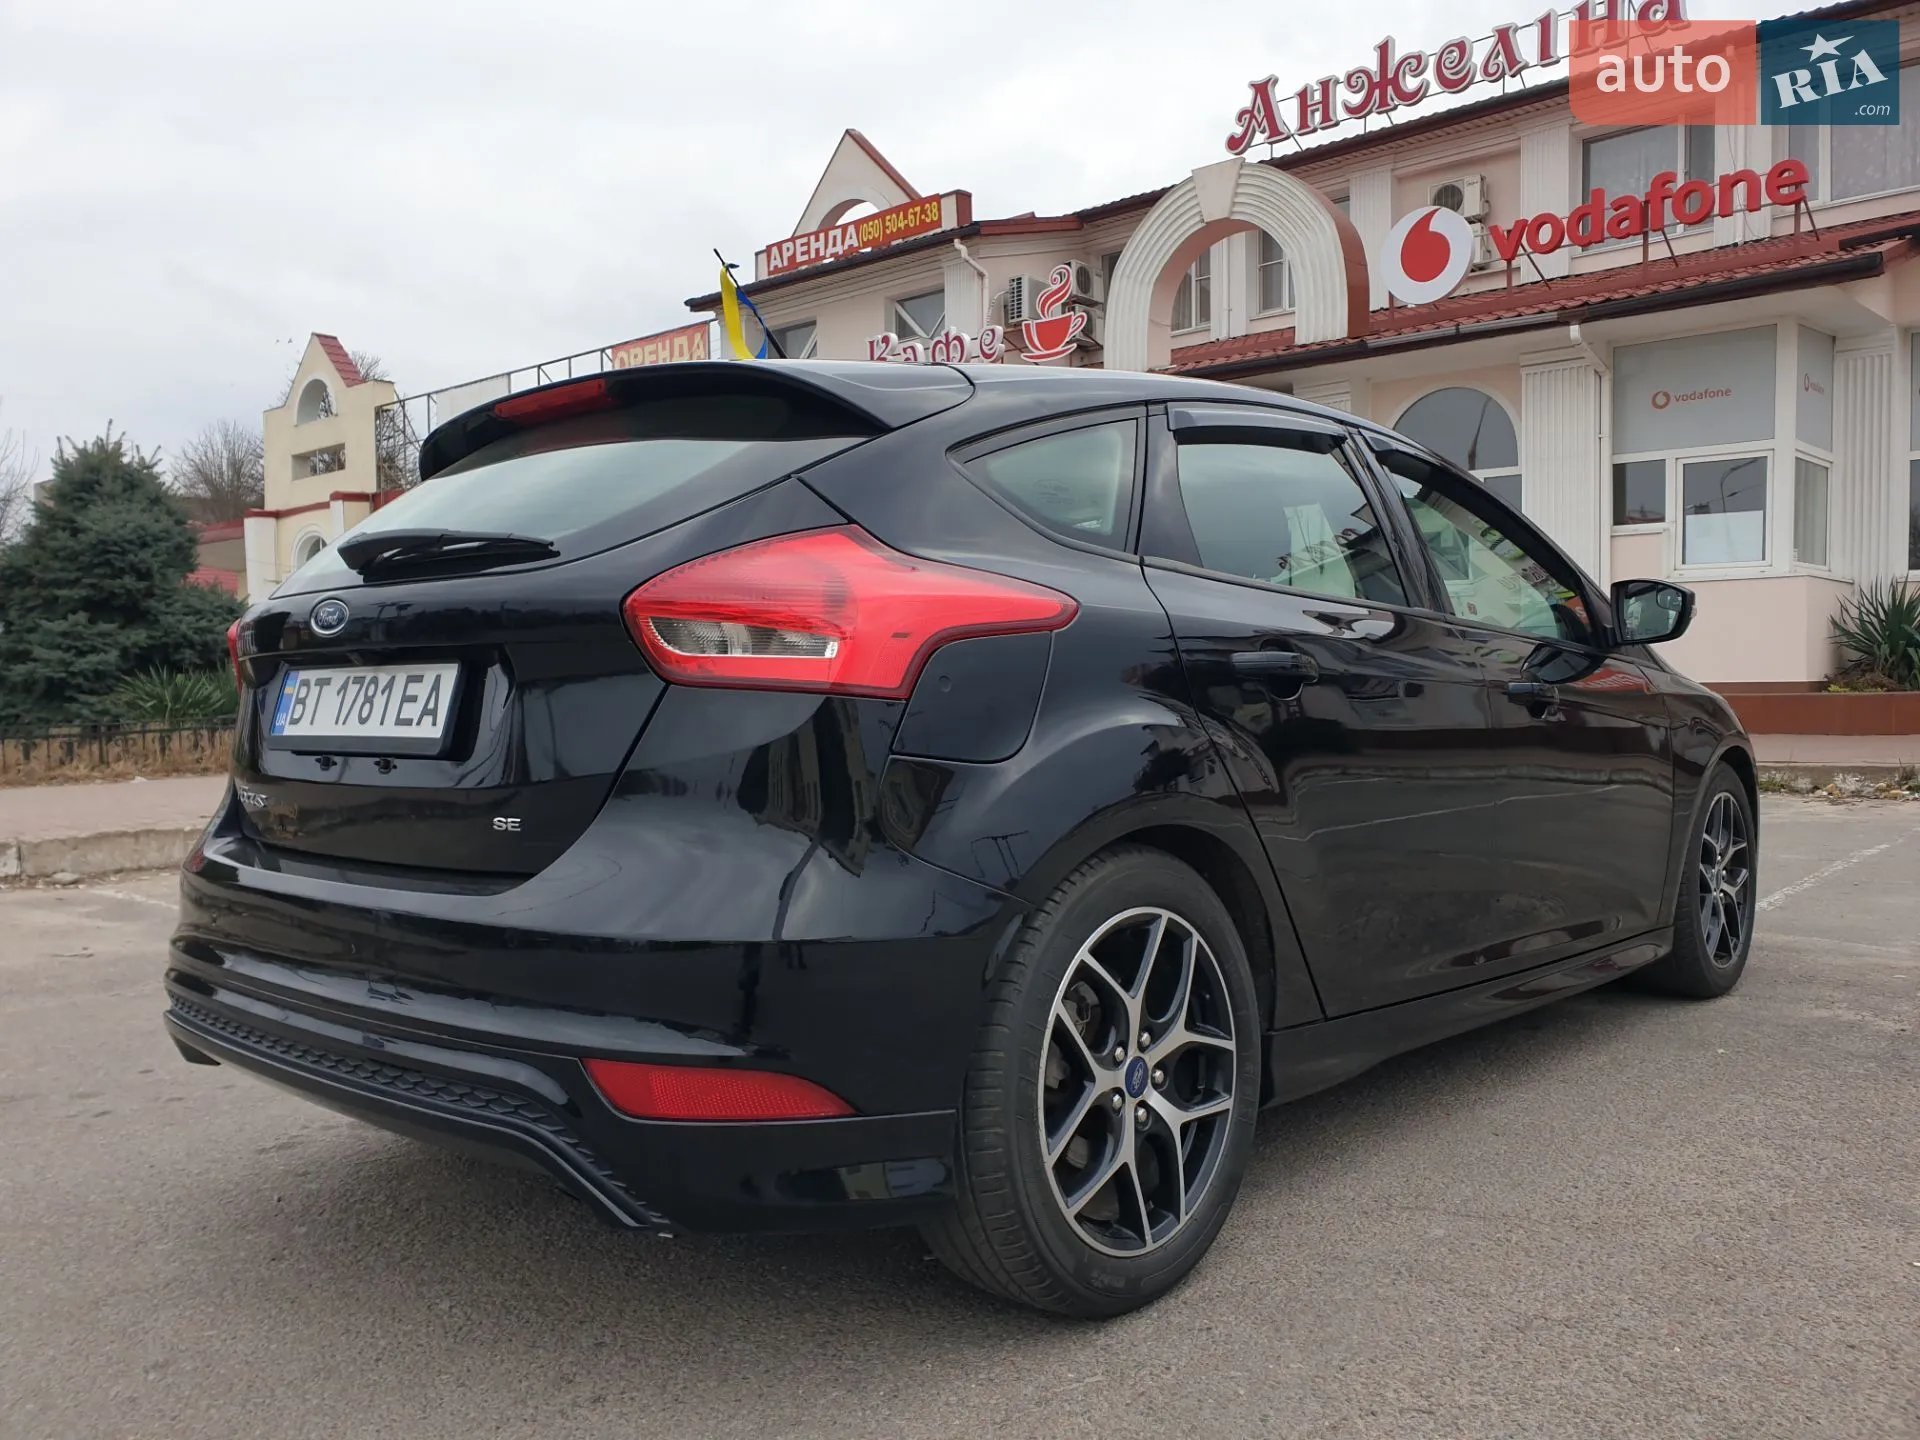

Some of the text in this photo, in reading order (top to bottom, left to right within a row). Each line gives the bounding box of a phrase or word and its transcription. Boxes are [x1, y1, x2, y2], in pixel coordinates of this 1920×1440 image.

[1488, 159, 1810, 262] vodafone
[769, 201, 939, 271] АРЕНДА (050) 504-67-38
[613, 331, 706, 369] ОРЕНДА
[1674, 387, 1732, 403] vodafone
[275, 712, 287, 727] UA
[289, 677, 332, 726] BT
[492, 816, 521, 831] SE
